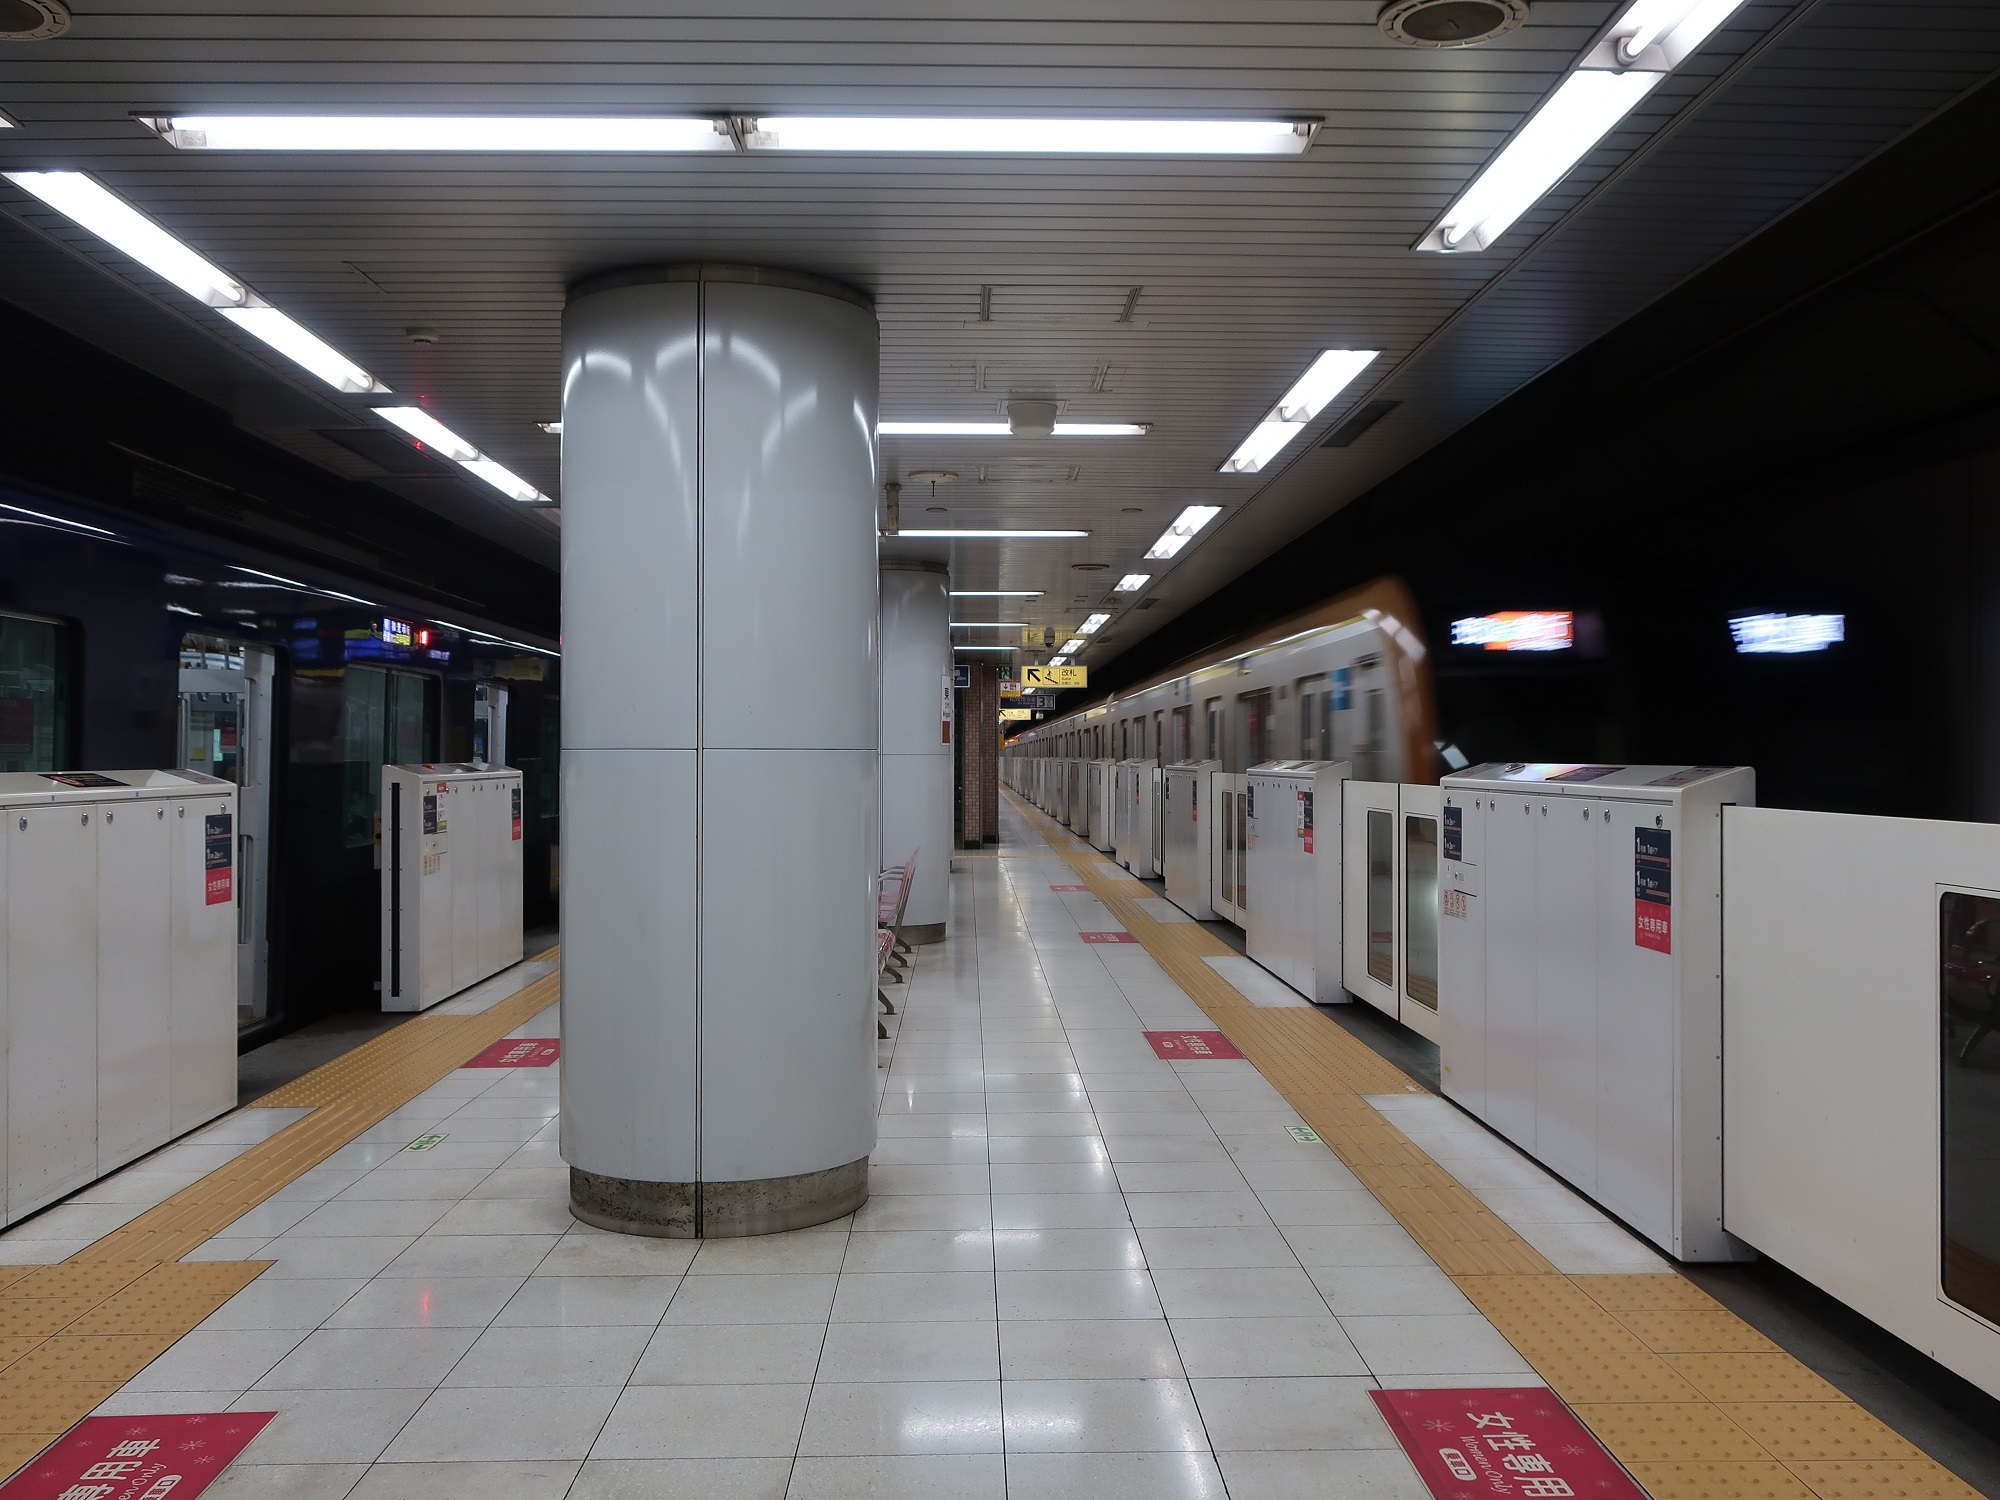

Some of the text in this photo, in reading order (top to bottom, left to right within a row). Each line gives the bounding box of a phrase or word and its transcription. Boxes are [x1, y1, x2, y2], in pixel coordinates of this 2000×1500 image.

[1061, 668, 1077, 677] 改札
[1038, 696, 1046, 707] 3
[1459, 1435, 1515, 1495] Women Only
[131, 1462, 167, 1486] Only
